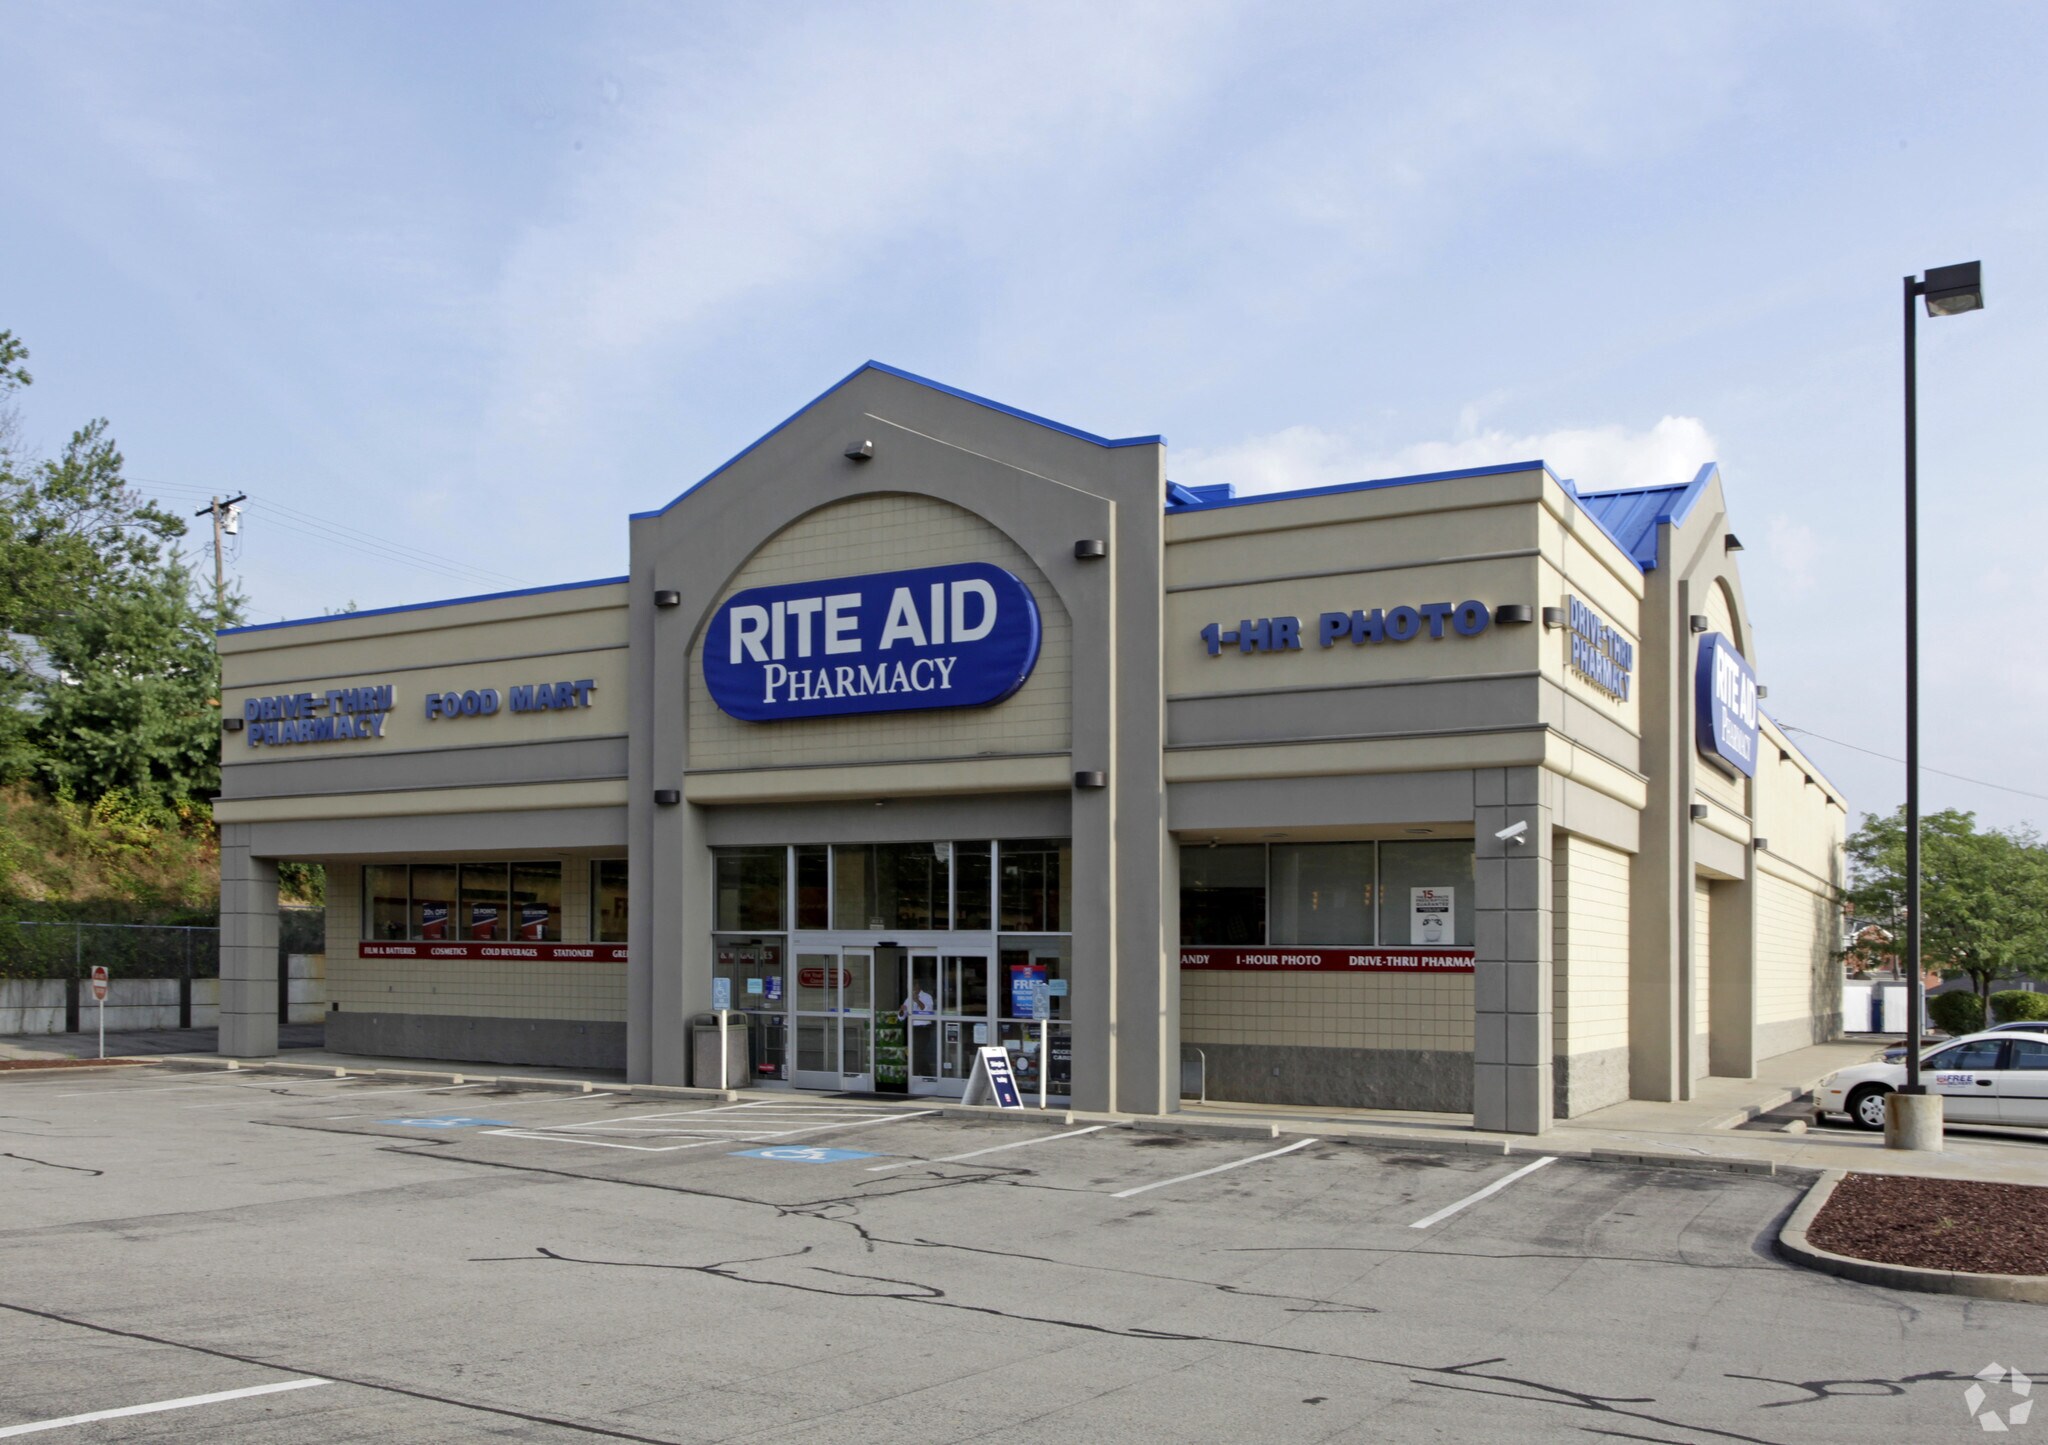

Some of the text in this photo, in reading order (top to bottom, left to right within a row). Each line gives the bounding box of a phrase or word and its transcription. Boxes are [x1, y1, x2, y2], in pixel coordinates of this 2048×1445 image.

[730, 578, 998, 664] RITE AID
[1200, 600, 1490, 656] 1-HR PHOTO
[1562, 594, 1633, 673] DRIVE-THRU
[763, 656, 957, 704] PHARMACY
[1569, 632, 1631, 702] PHARMACY
[244, 684, 396, 722] DRIVE-THRU
[425, 679, 597, 720] FOOD MART
[1716, 644, 1758, 730] RITE AID
[247, 712, 391, 747] PHARMACY
[1422, 889, 1434, 899] 15
[364, 946, 417, 955] FILM & BATTERIES
[431, 947, 467, 956] COSMETICS
[481, 947, 538, 957] COLD BEVERAGES
[553, 949, 594, 958] STATIONERY
[1236, 955, 1322, 966] 1-HOUR PHOTO
[1349, 956, 1418, 967] DRIVE-THRU
